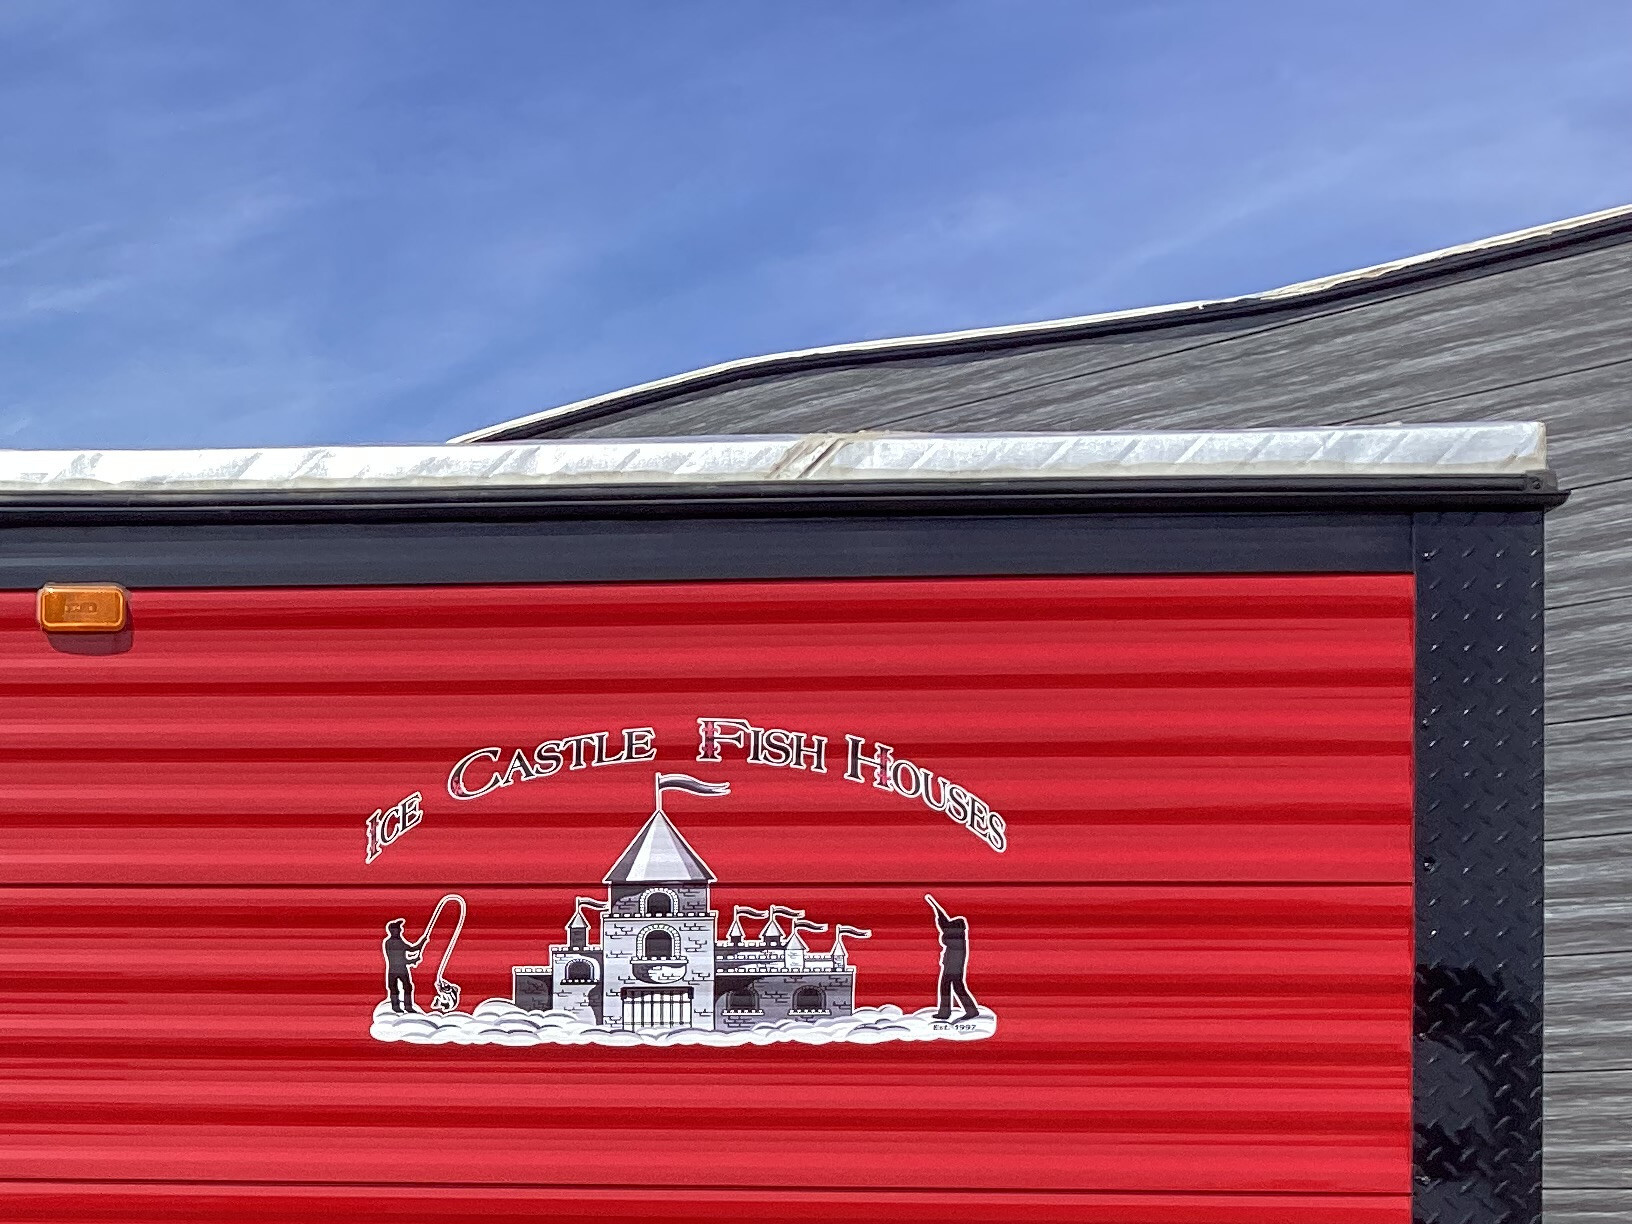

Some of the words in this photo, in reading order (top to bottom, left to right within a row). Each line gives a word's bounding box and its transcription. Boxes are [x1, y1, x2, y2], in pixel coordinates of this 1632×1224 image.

[365, 789, 424, 865] ICE
[447, 727, 658, 801] CASTLE
[695, 716, 829, 774] FISH
[843, 733, 1008, 853] HOUSES
